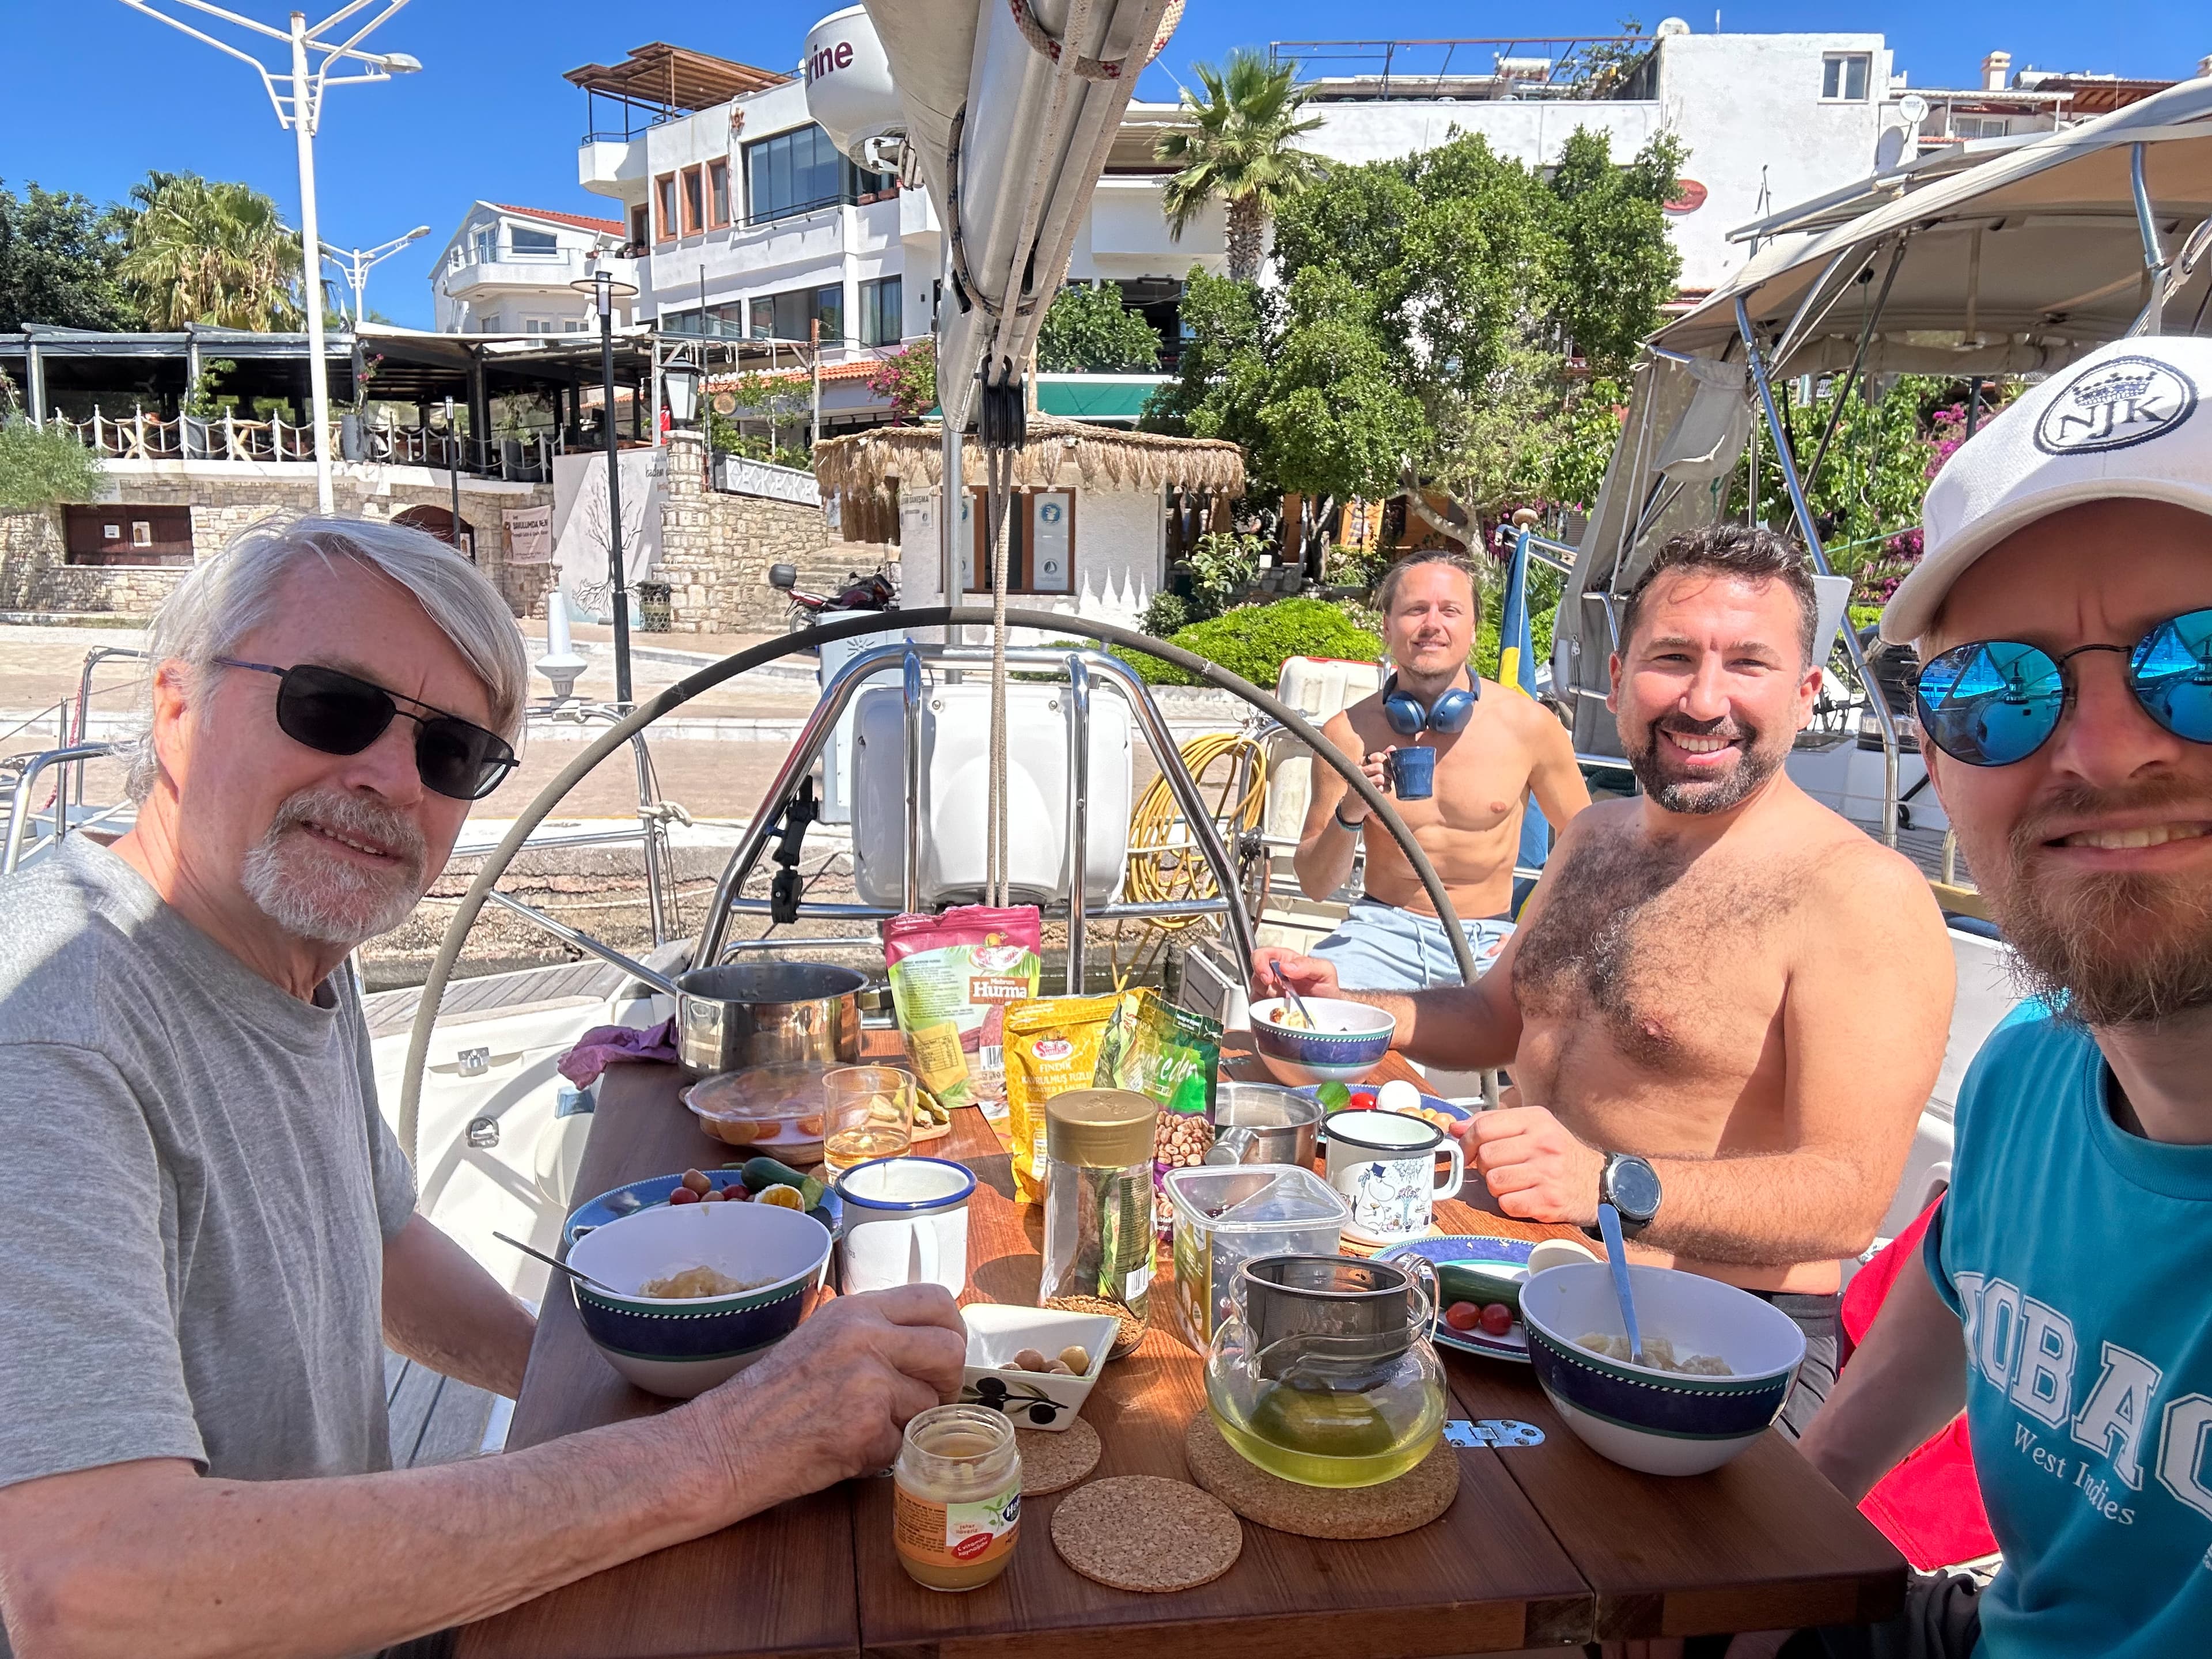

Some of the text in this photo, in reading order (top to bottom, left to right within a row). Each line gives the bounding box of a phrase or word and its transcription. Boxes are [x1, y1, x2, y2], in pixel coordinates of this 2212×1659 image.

[2056, 396, 2168, 441] NJK
[972, 981, 1027, 999] Hurma
[1039, 1060, 1072, 1073] FINDIK
[1069, 1071, 1092, 1082] TUZLU
[2014, 1422, 2135, 1525] West Indies
